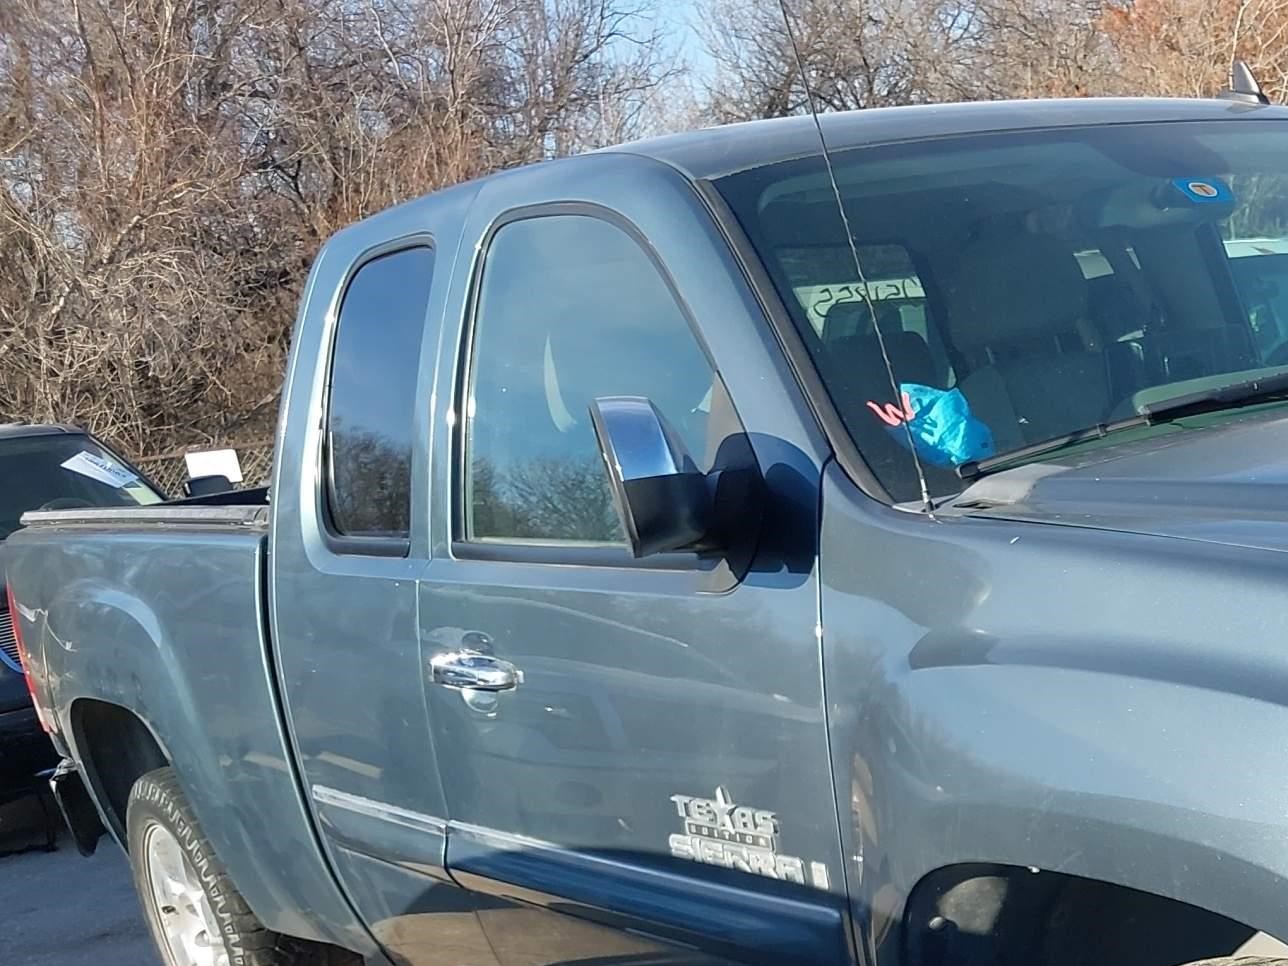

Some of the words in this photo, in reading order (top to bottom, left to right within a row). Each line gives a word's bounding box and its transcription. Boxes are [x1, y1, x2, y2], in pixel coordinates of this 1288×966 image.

[669, 785, 778, 834] TEXAS
[669, 833, 806, 885] SIERRA
[690, 823, 770, 848] EDITION
